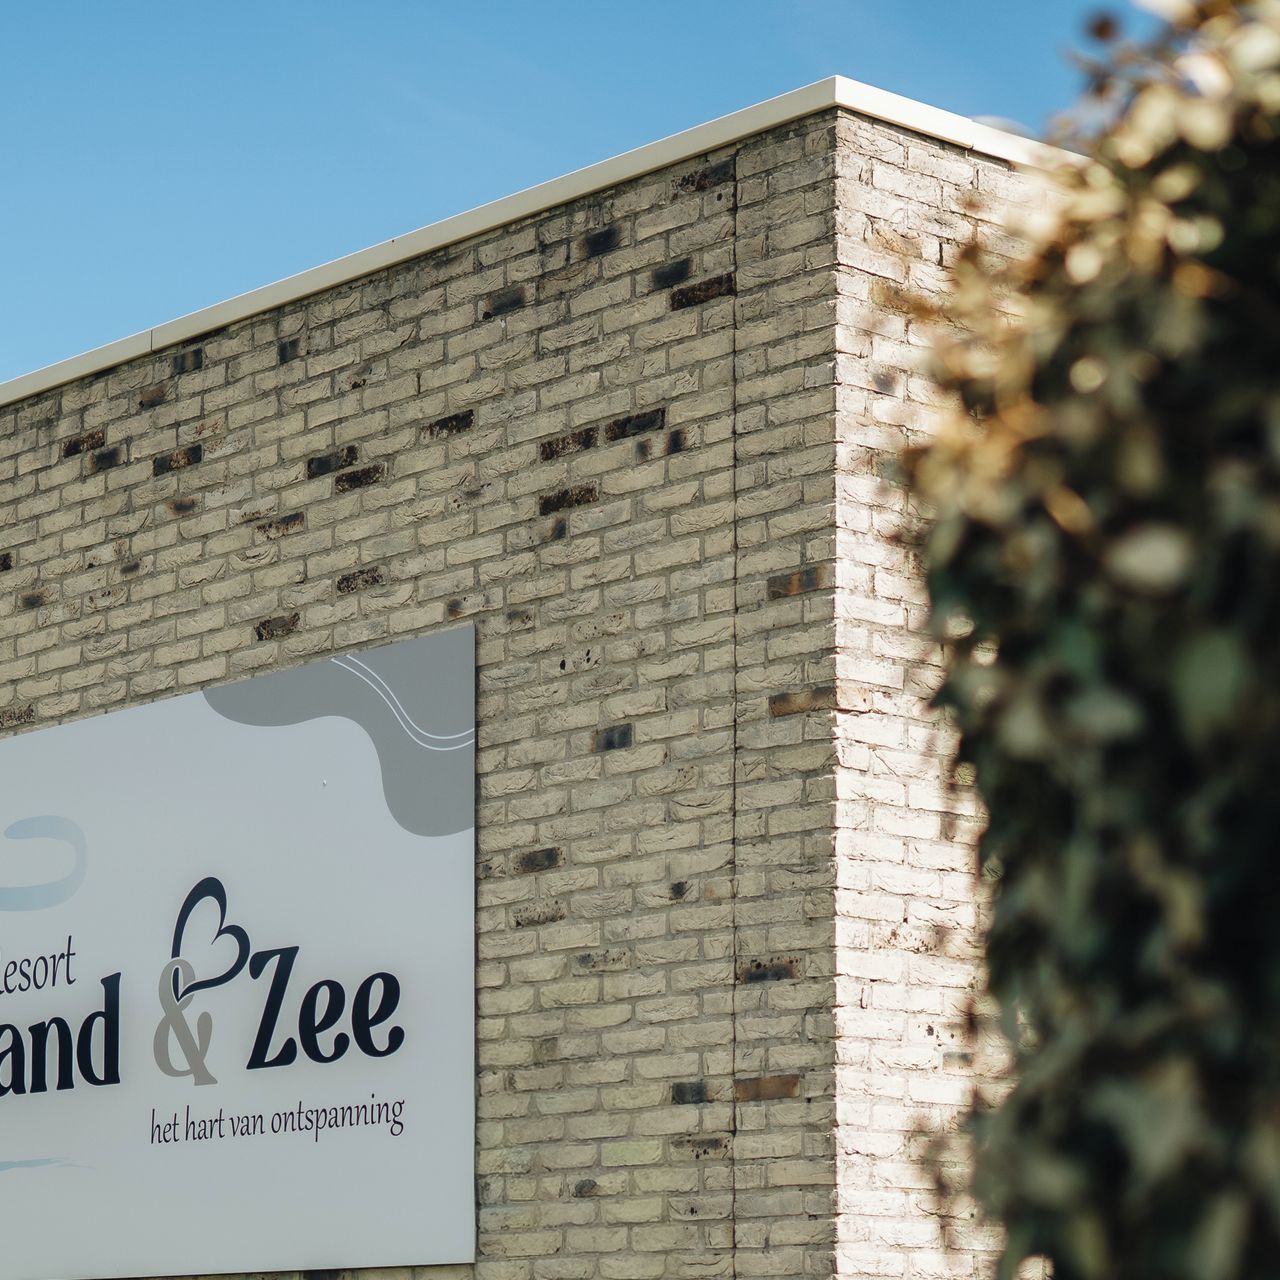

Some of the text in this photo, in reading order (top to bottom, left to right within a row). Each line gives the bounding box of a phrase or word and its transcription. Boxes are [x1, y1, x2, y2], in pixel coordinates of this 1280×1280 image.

[152, 957, 219, 1087] &
[245, 945, 406, 1071] Zee
[150, 1093, 406, 1145] het hart van ontspanning
